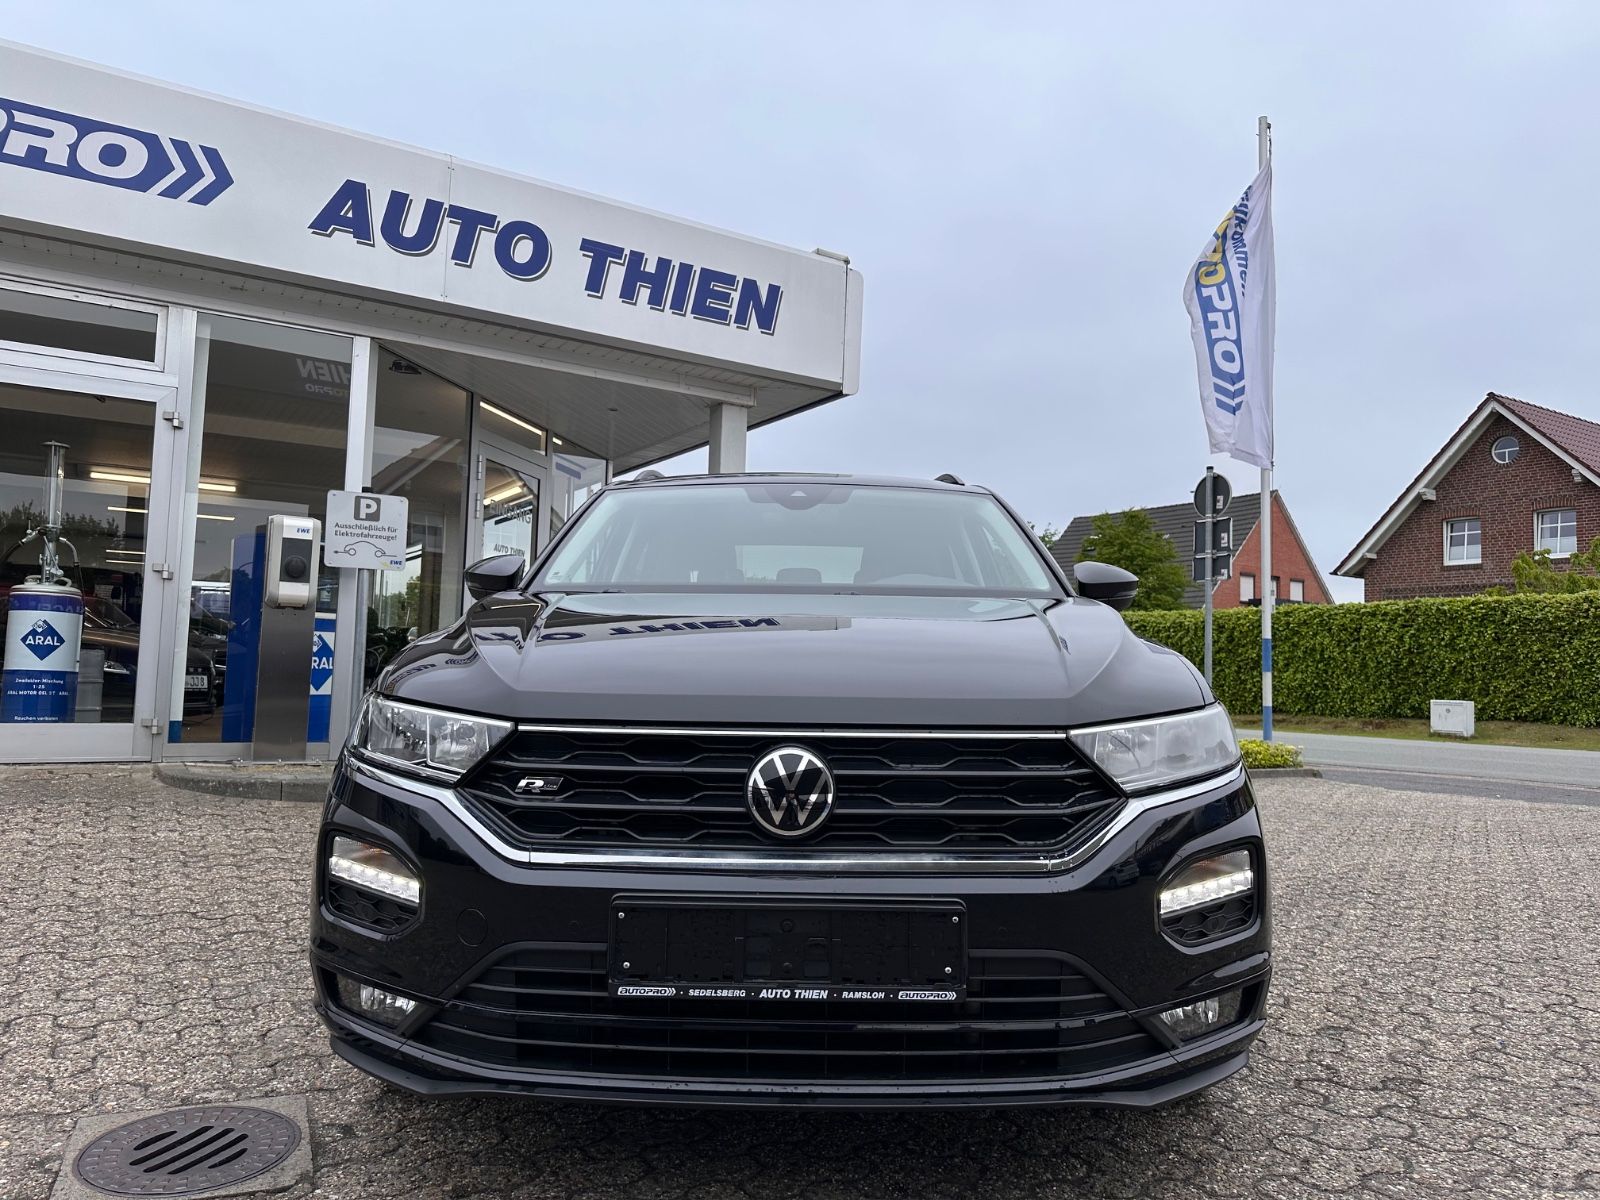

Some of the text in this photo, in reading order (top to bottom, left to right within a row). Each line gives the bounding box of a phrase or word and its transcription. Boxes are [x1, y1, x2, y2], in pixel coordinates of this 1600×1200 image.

[0, 108, 149, 179] RO
[307, 178, 784, 336] AUTO THIEN
[359, 498, 378, 519] P
[334, 522, 387, 533] Ausschließlich
[334, 530, 398, 542] Elektrofahrzeuge!
[493, 543, 526, 557] AUTO THIEN
[25, 635, 61, 646] ARAL
[311, 656, 333, 670] RAL
[688, 988, 746, 997] SEDELSBERG
[759, 989, 791, 999] AUTO
[794, 989, 829, 999] THIEN
[842, 991, 885, 999] RAMSLOH
